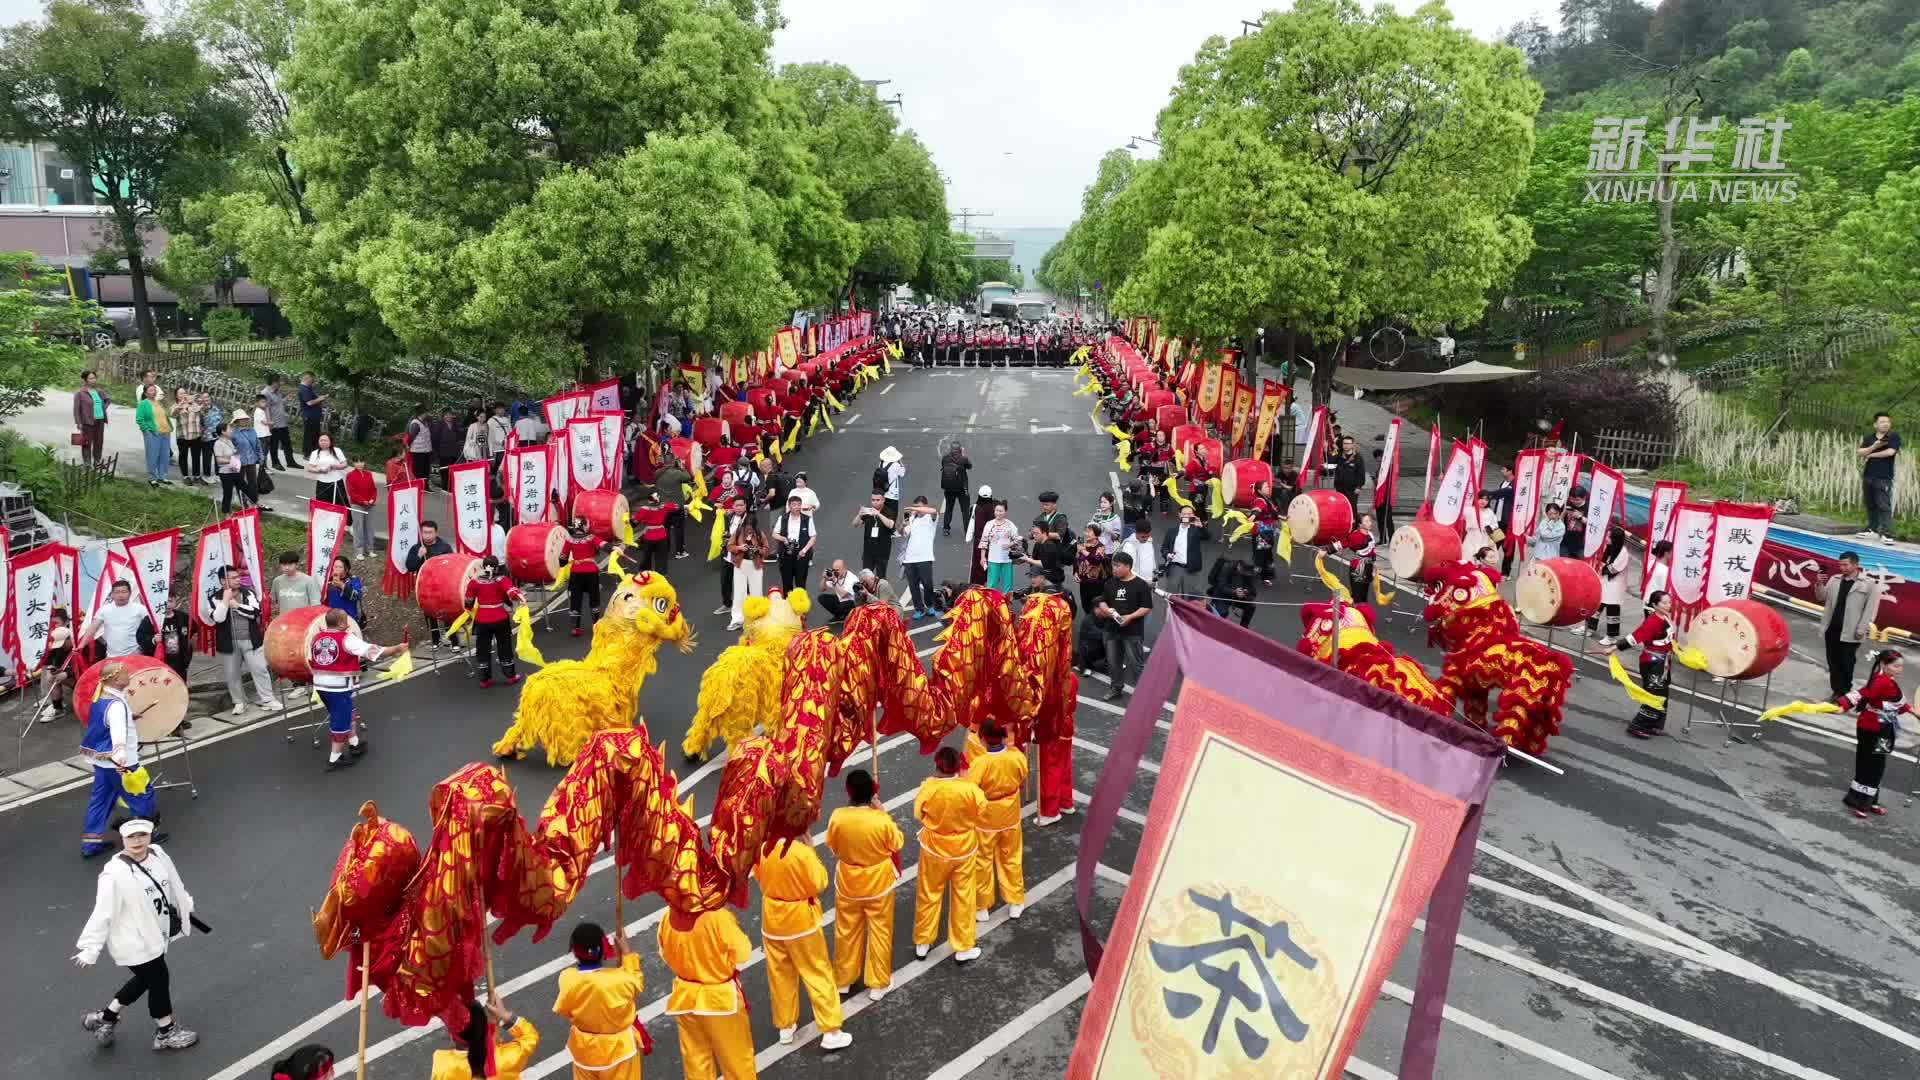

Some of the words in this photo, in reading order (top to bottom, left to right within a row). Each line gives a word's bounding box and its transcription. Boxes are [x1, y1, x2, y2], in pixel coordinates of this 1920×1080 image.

[464, 484, 484, 530] 湾坪村
[523, 460, 540, 513] 磨刀岩村
[1722, 527, 1753, 598] 默戎镇
[1149, 887, 1319, 1060] 茶
